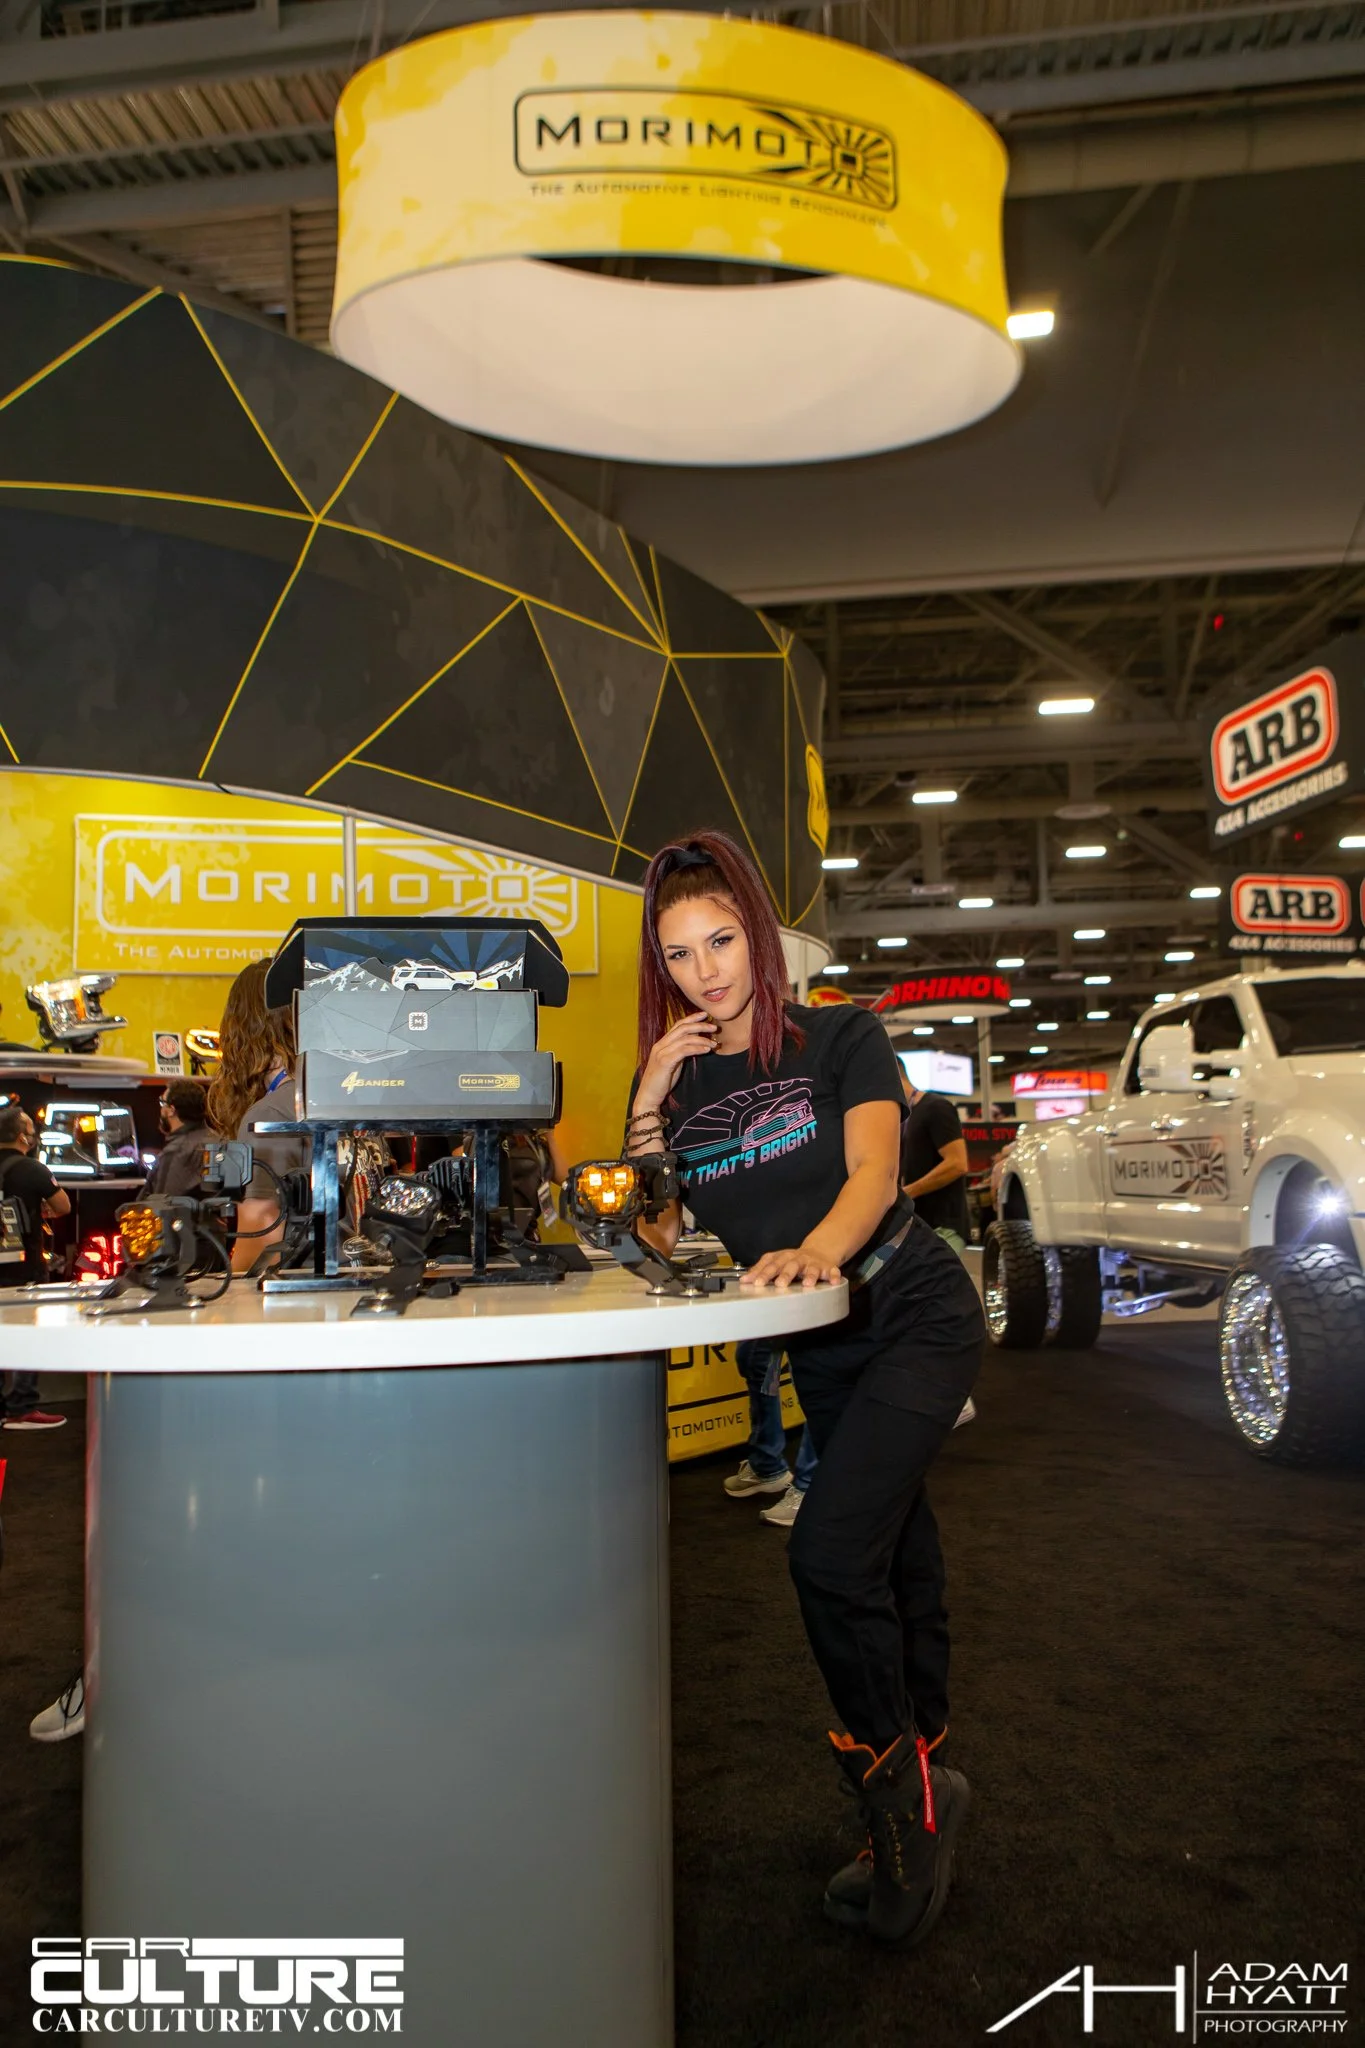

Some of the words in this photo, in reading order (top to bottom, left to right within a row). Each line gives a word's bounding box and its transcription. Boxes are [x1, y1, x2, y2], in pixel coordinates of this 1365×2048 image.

[1230, 694, 1321, 785] ARB
[1249, 888, 1336, 919] ARB
[114, 942, 165, 959] THE
[696, 1150, 756, 1185] THAT'S
[760, 1120, 818, 1164] BRIGHT
[667, 1412, 744, 1440] TOMOTIVE
